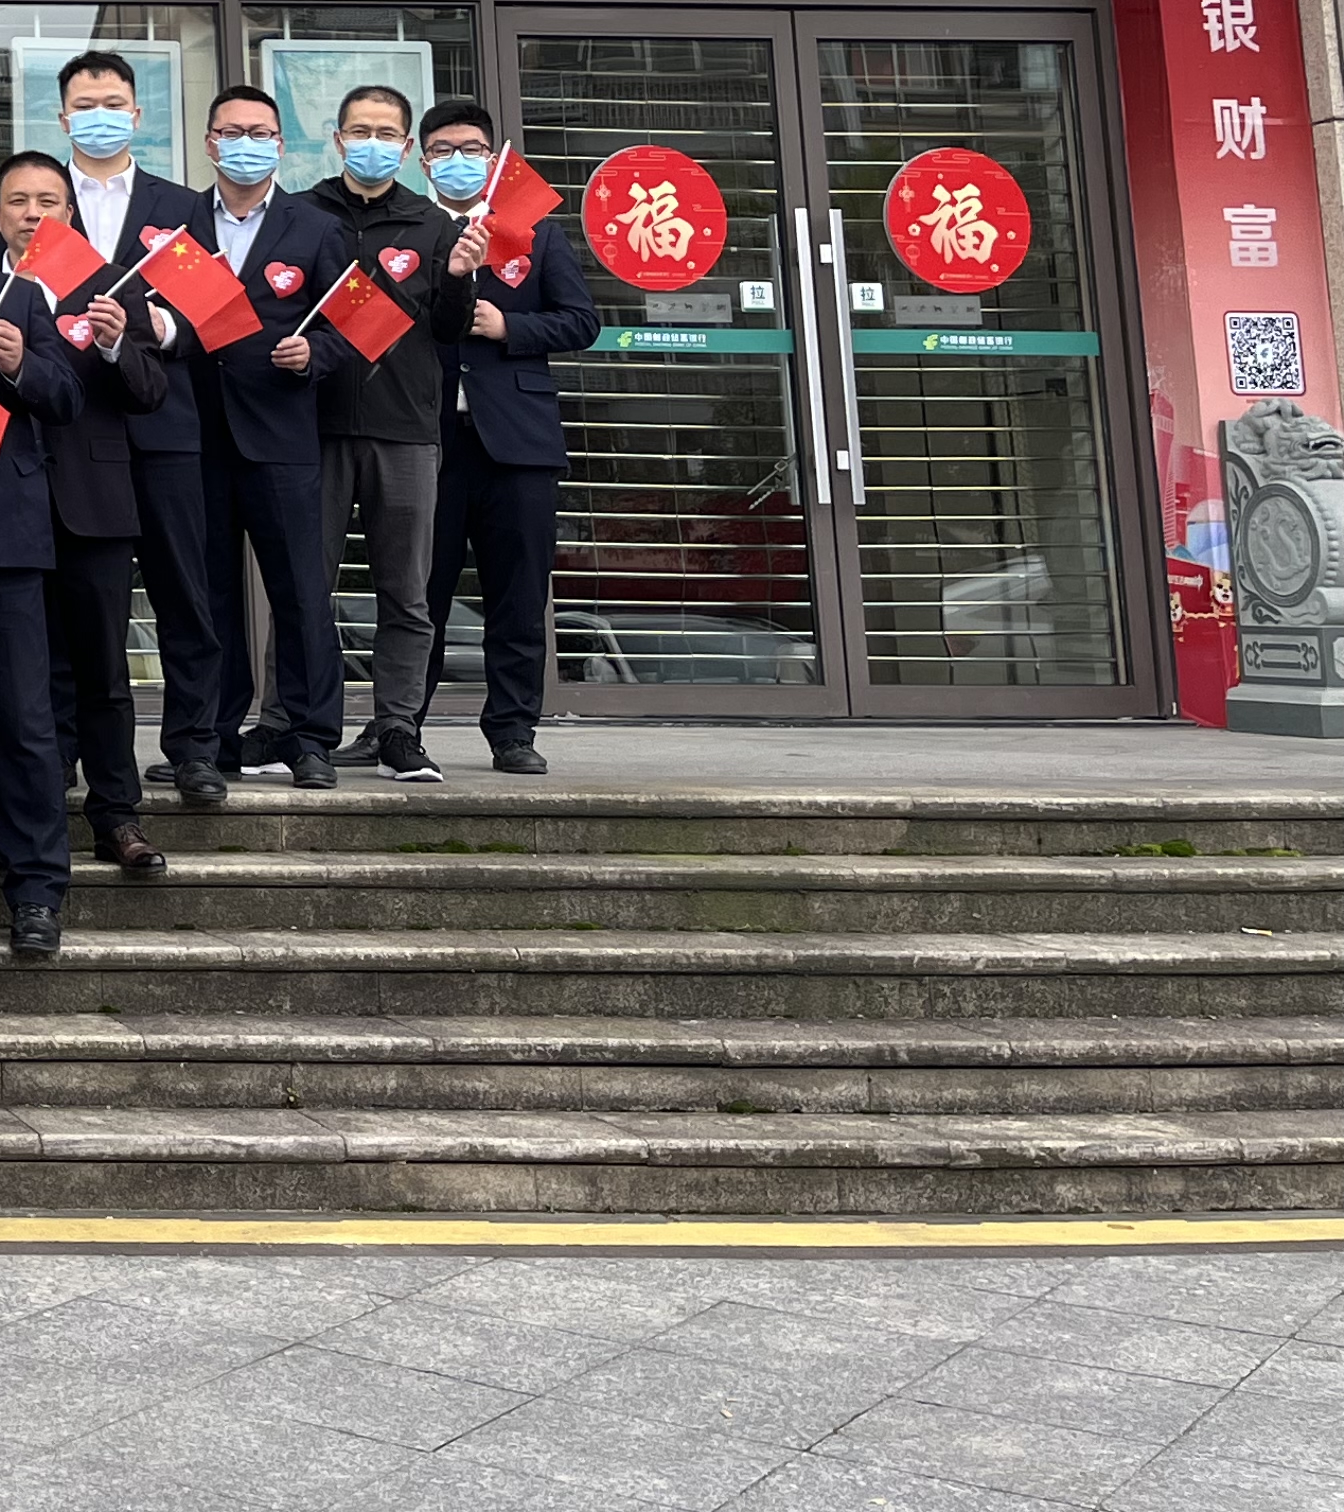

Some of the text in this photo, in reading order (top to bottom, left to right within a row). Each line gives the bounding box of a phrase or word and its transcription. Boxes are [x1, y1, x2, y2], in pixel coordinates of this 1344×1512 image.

[616, 180, 694, 263] 福
[919, 183, 998, 265] 福
[750, 285, 766, 300] 拉
[860, 286, 876, 301] 拉
